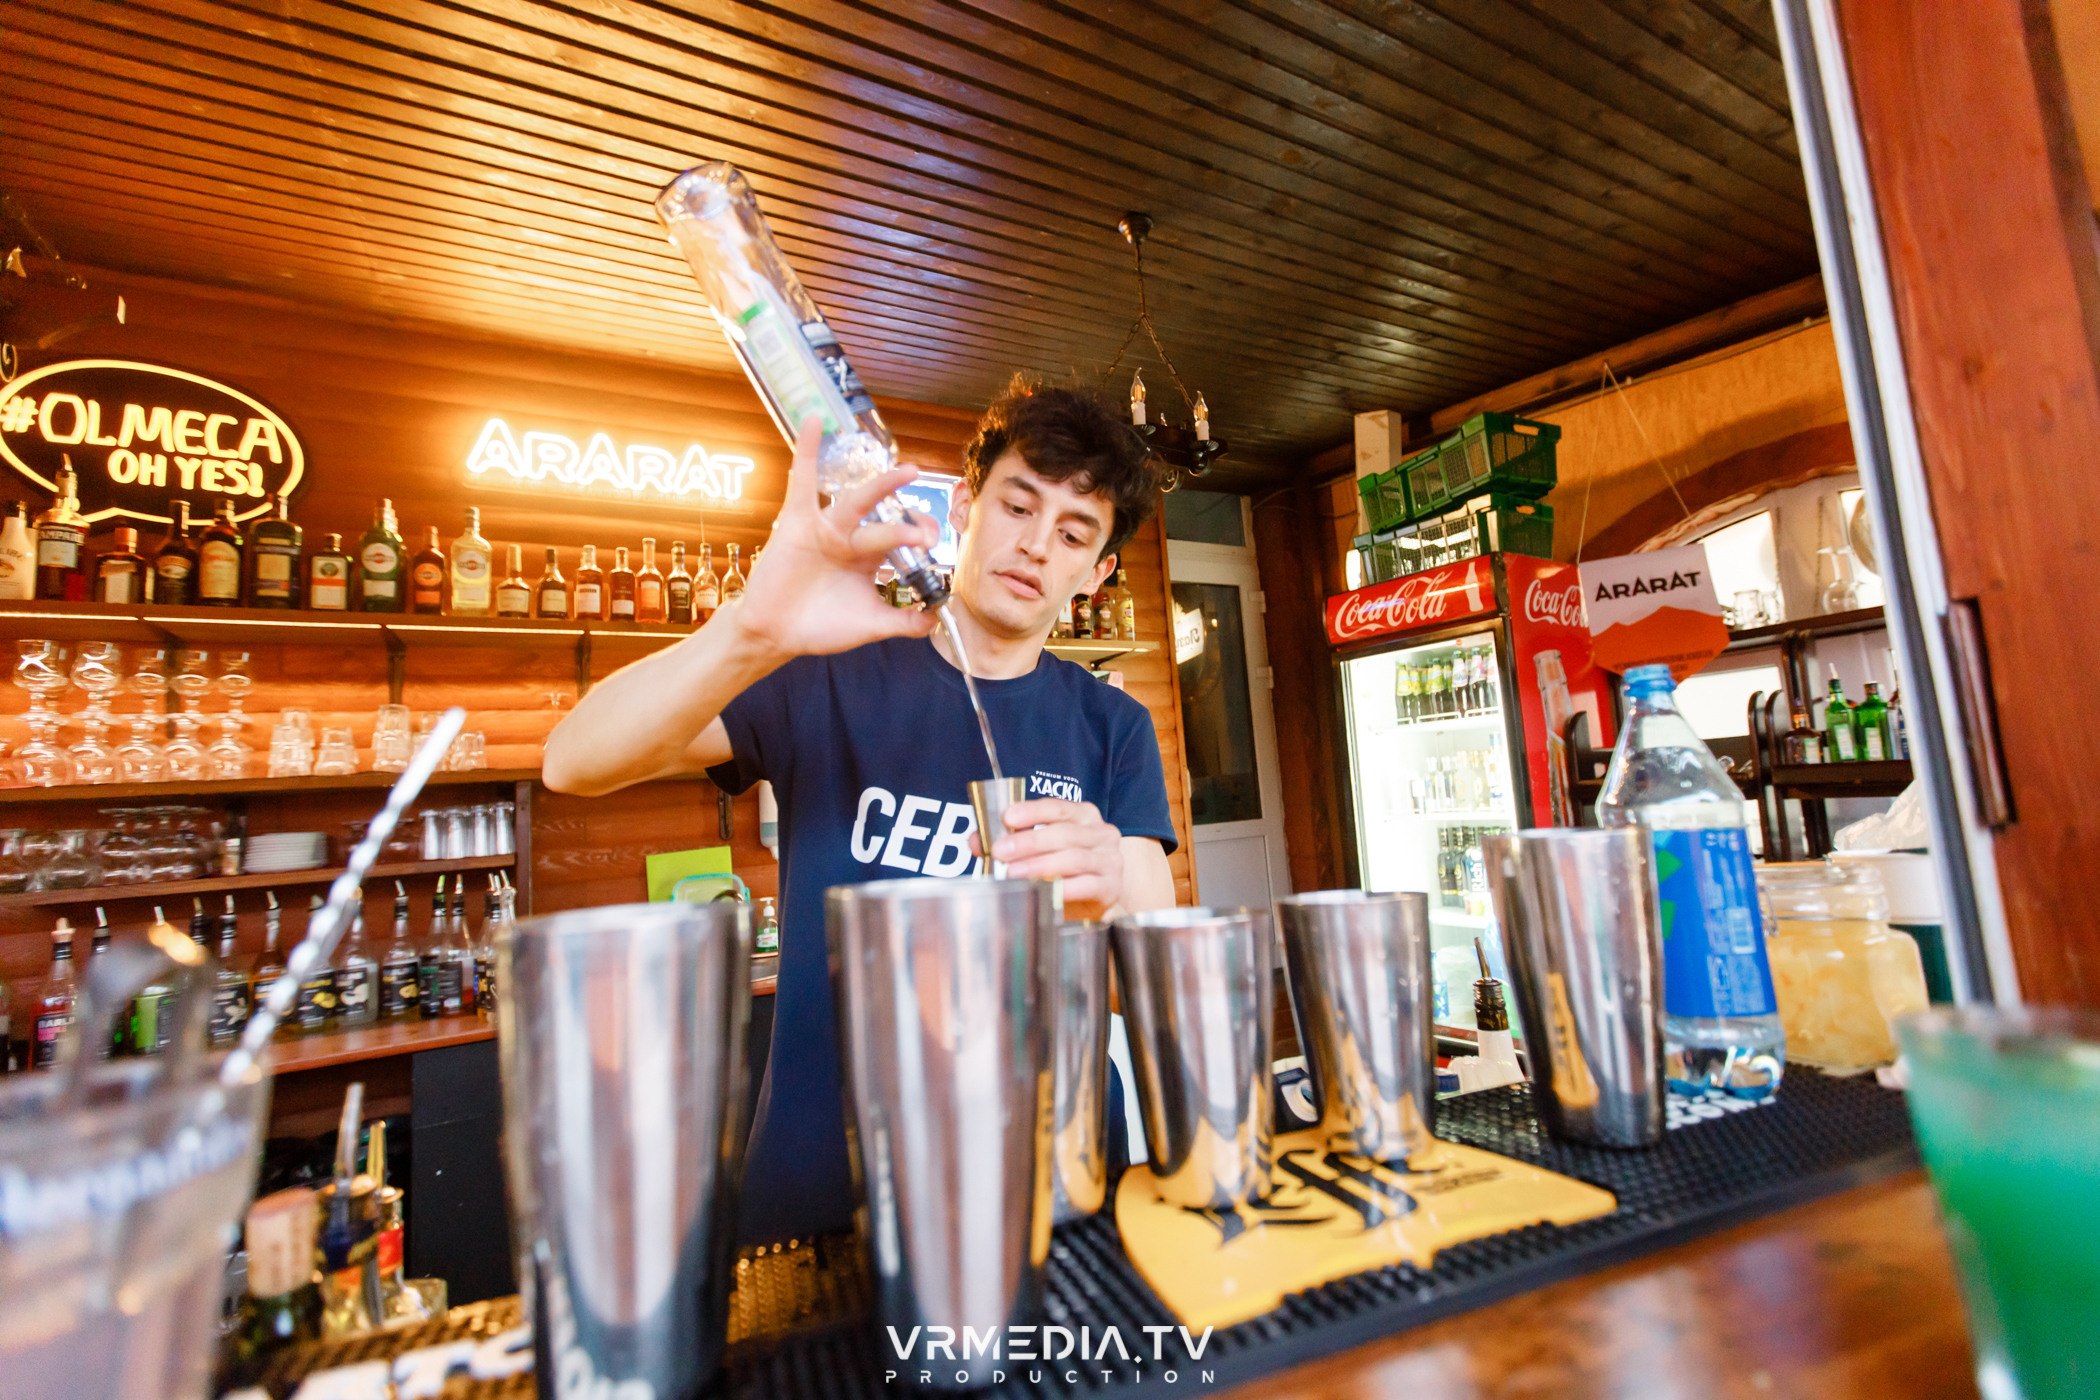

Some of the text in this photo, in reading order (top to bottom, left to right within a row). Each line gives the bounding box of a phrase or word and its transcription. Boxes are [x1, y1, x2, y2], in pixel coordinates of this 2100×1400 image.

[0, 391, 283, 464] #OLMECA
[107, 449, 266, 498] OH YES!
[465, 417, 755, 501] ARARAT
[1335, 569, 1454, 638] Coca-Cola
[1596, 571, 1701, 602] ARARAT
[1035, 770, 1062, 780] PREMIUM
